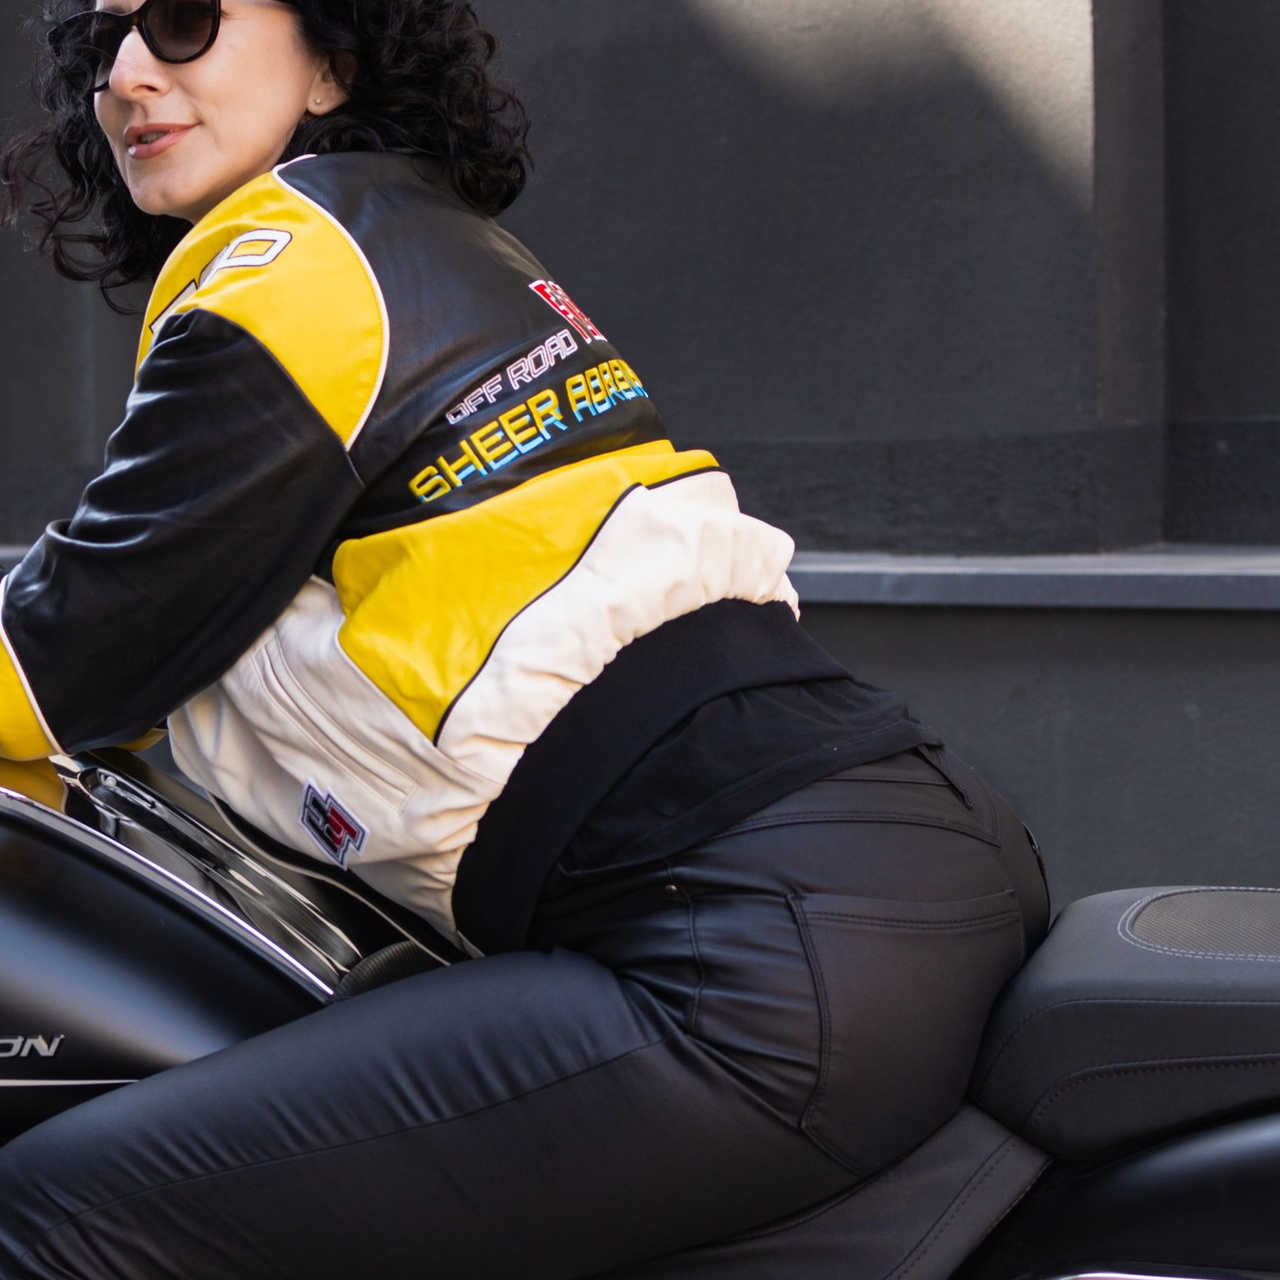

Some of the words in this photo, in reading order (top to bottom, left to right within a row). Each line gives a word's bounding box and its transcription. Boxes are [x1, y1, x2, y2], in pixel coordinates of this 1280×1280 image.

[445, 373, 503, 425] OFF
[506, 328, 578, 391] ROAD
[408, 388, 569, 503] SHEER
